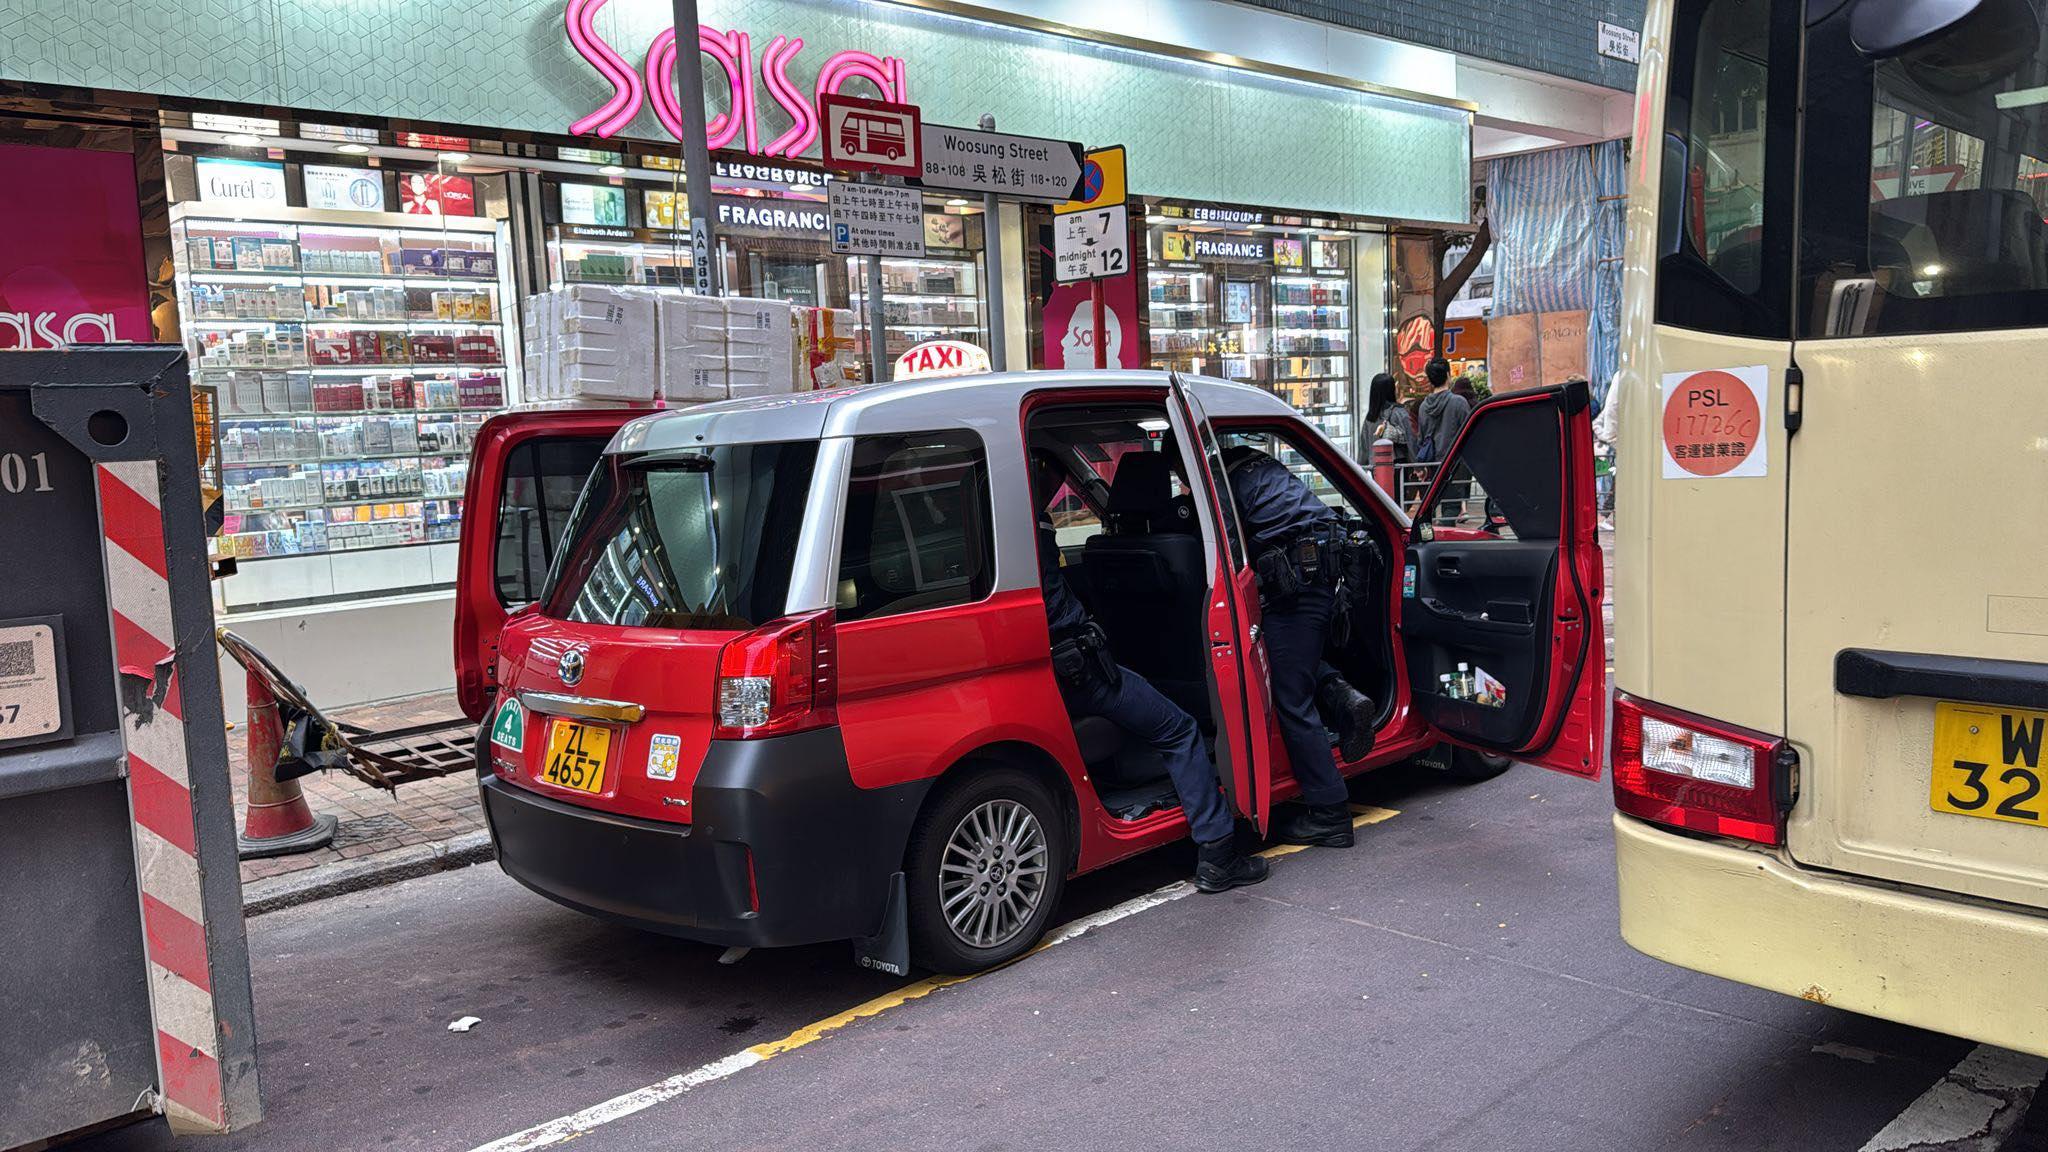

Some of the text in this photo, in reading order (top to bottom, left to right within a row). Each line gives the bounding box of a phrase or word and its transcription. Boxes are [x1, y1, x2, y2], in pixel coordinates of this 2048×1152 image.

[943, 134, 1049, 161] Woosung Street
[972, 164, 1025, 187] 吳松街
[210, 176, 255, 199] Curél
[718, 205, 831, 230] FRAGRANC
[1069, 216, 1083, 225] am
[1099, 212, 1111, 235] 7
[877, 229, 895, 237] times
[1066, 226, 1087, 240] 上午
[1059, 249, 1097, 262] midnight
[1101, 247, 1123, 271] 12
[1195, 240, 1263, 258] FRAGRANCE
[1068, 263, 1088, 276] 午夜
[903, 346, 963, 373] TAXI
[1688, 388, 1729, 408] PSL
[1, 452, 54, 493] 01
[506, 701, 519, 715] TAXI
[504, 714, 513, 733] 4
[496, 731, 517, 747] SEATS
[564, 724, 588, 757] ZL
[2001, 714, 2045, 768] W
[548, 753, 601, 791] 4657
[1946, 759, 2041, 821] 32
[872, 959, 900, 975] TOYOTA
